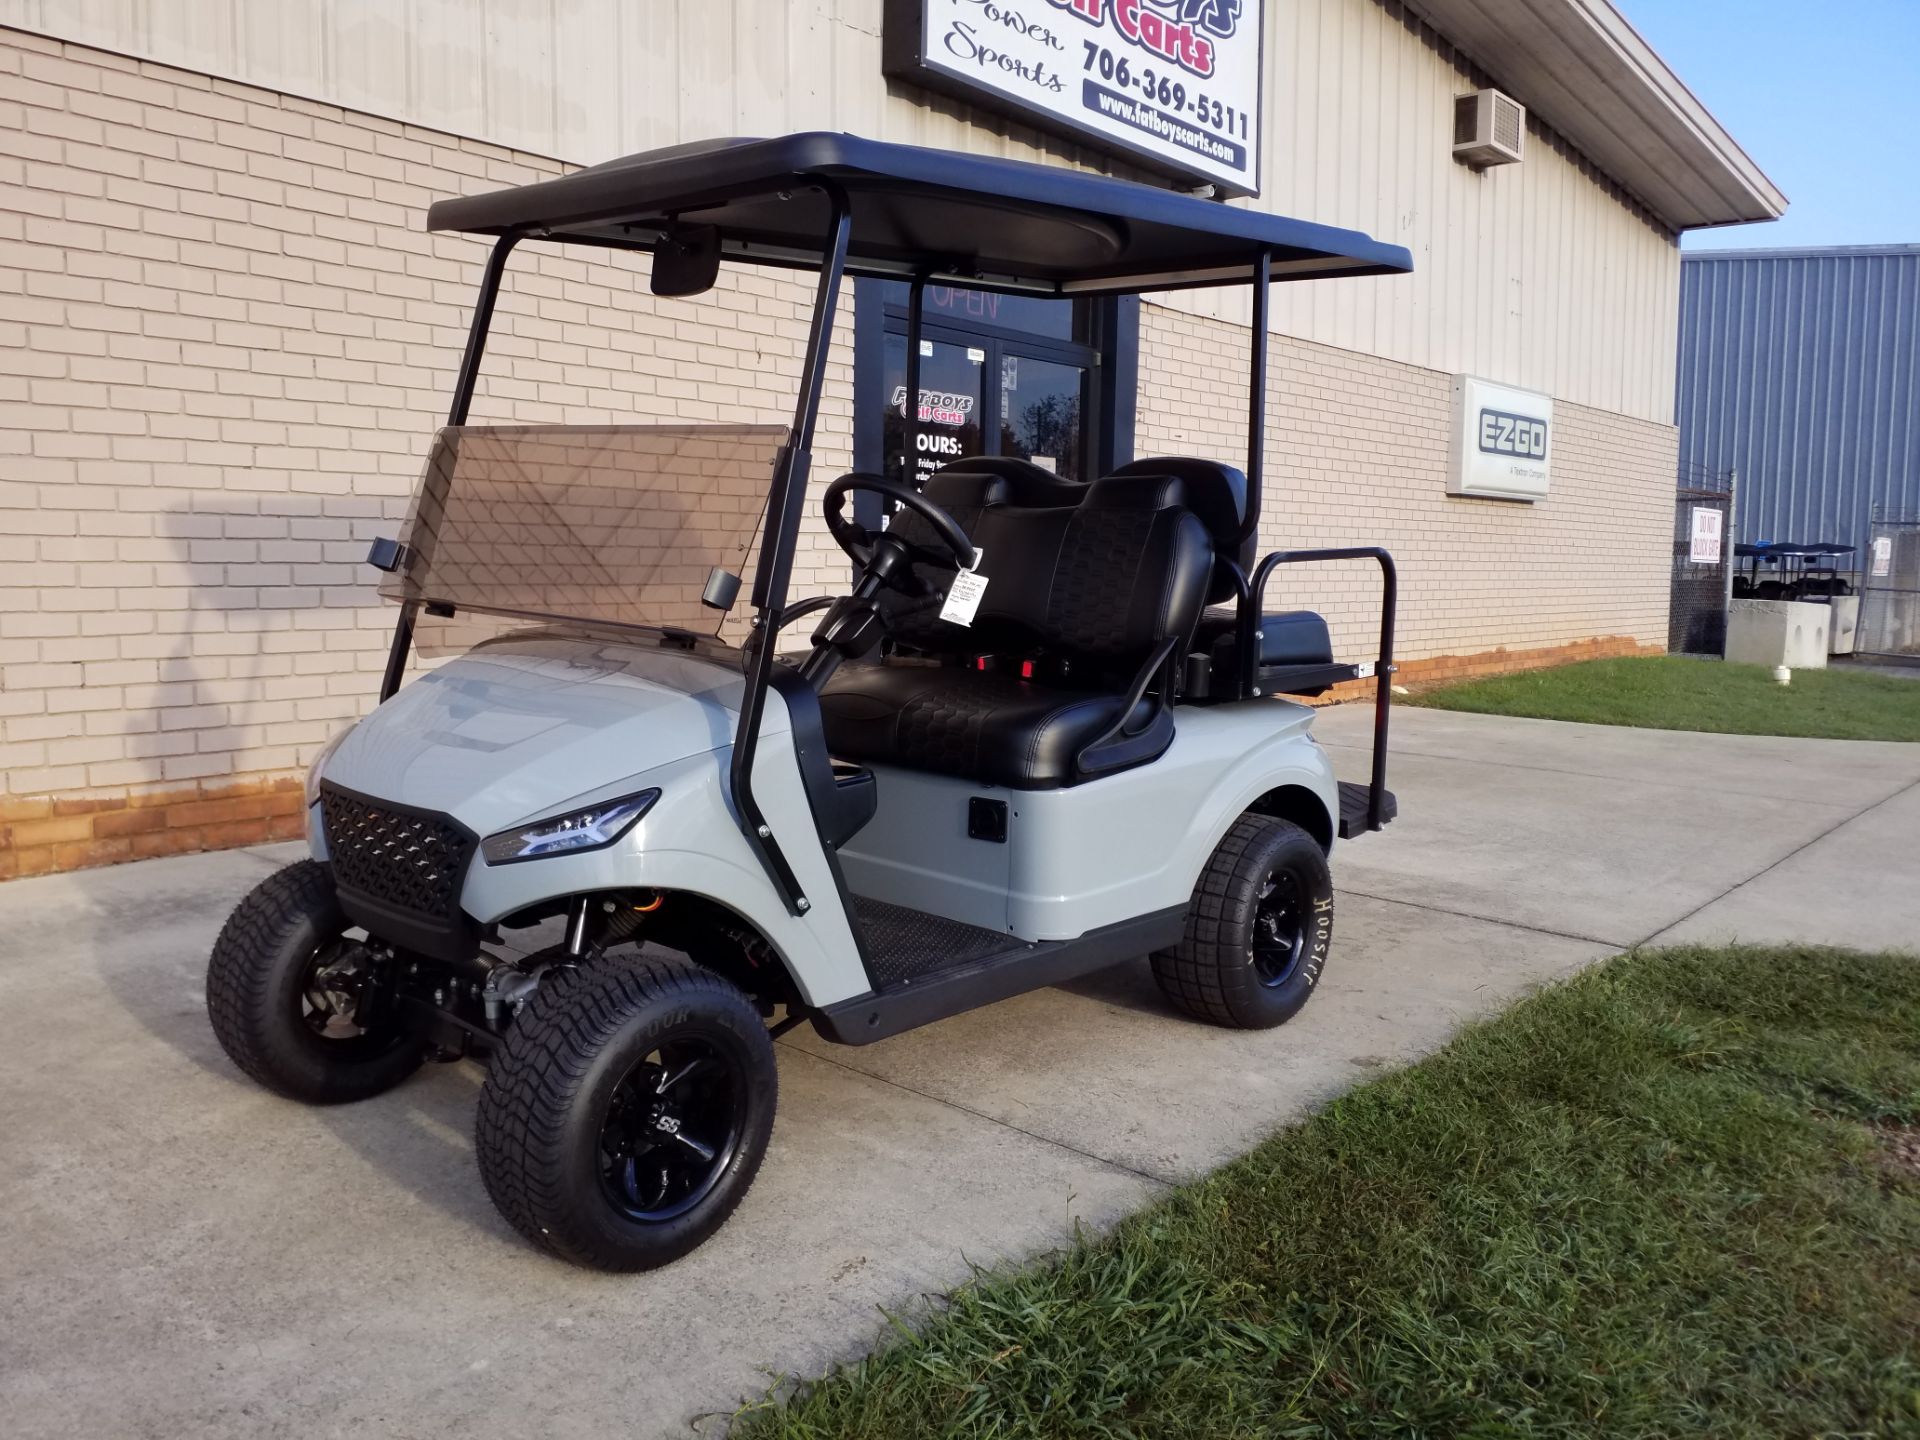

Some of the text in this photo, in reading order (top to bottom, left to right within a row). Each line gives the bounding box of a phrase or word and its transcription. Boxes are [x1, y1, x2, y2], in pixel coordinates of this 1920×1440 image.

[943, 20, 1067, 93] Sports
[1114, 0, 1213, 73] Carts
[1083, 38, 1248, 141] 706-369-5311
[1098, 92, 1235, 163] www.fatboyscarts.com
[892, 386, 973, 412] FT BOYS
[932, 408, 965, 426] Carts
[903, 433, 963, 456] OURS:
